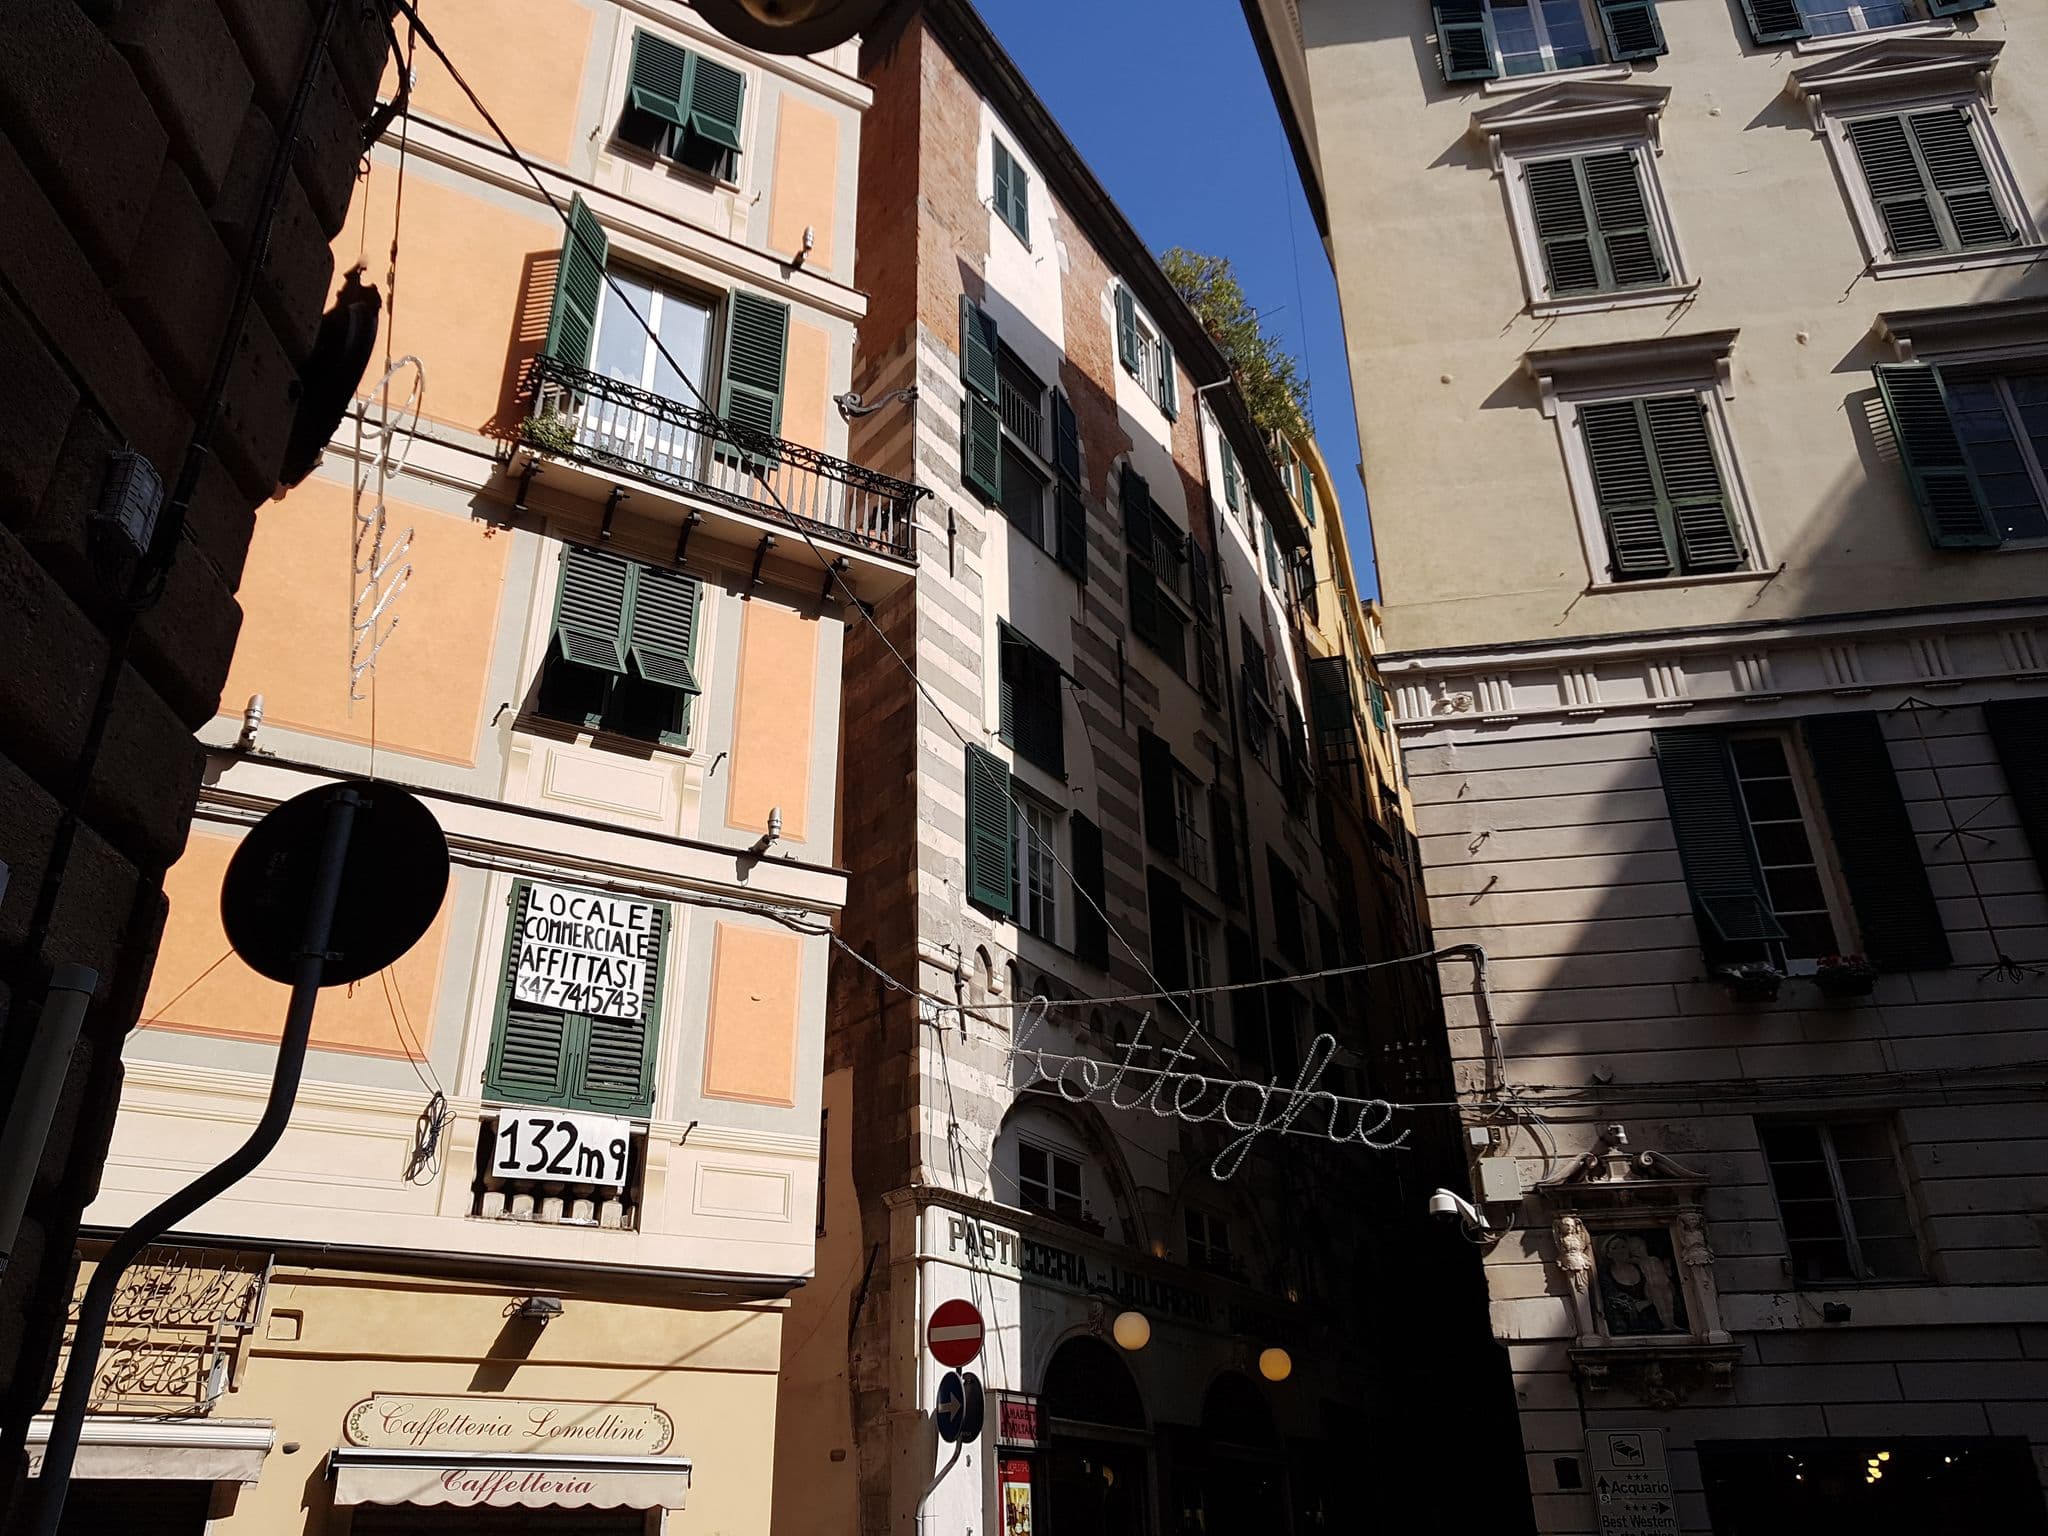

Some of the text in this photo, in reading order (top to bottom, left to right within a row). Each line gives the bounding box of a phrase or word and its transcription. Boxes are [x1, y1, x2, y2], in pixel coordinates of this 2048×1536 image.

[530, 889, 649, 930] LOCALE
[524, 916, 649, 960] COMMERCIALE
[519, 944, 637, 990] AFFITTASI
[516, 975, 640, 1017] 347-7415743
[1004, 995, 1411, 1182] botteghe
[947, 1215, 1089, 1288] PASTICCERIA
[378, 1401, 649, 1446] Caffetteria Lomellini
[440, 1469, 598, 1502] Caffetteria
[1611, 1481, 1669, 1495] Acquario
[1601, 1515, 1676, 1528] Best Western
